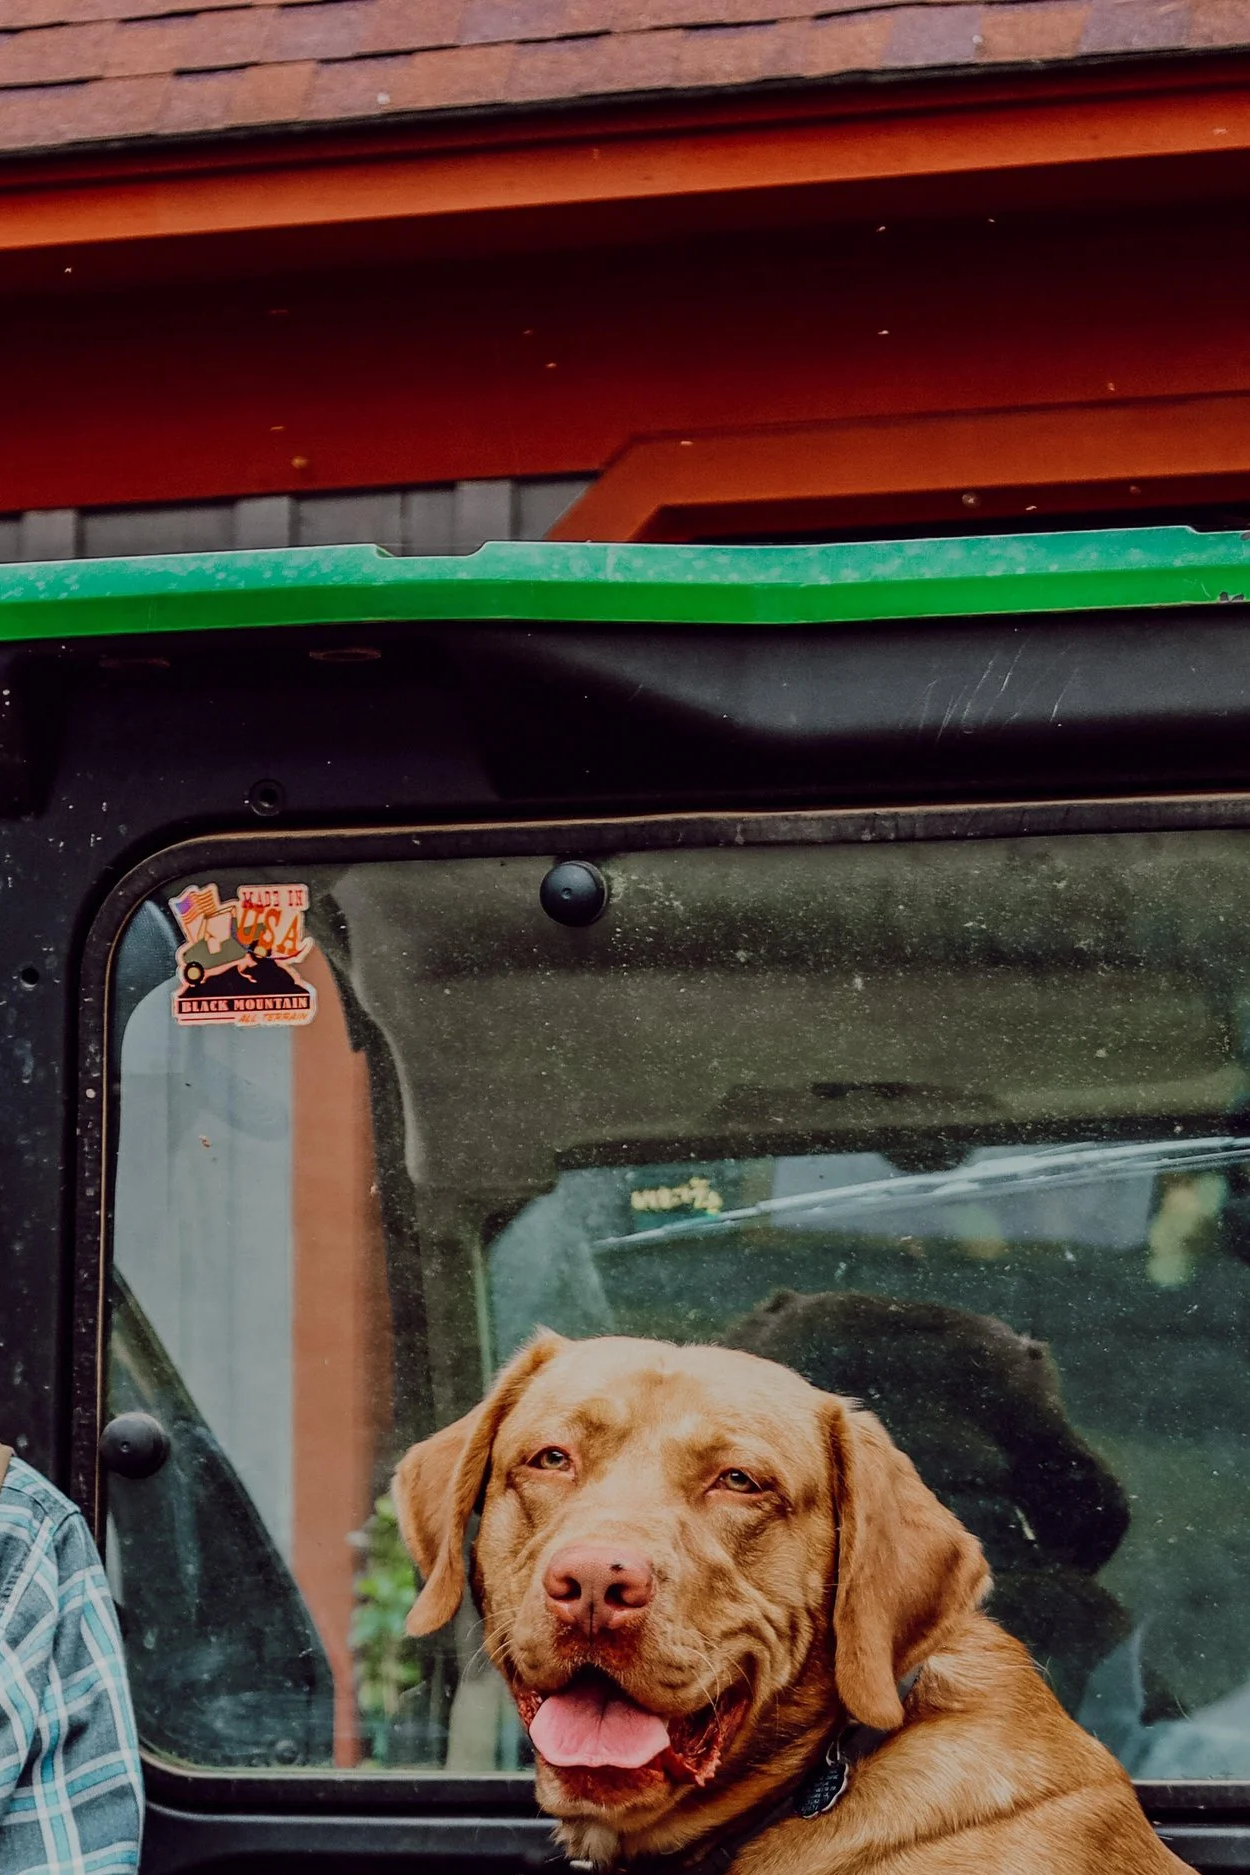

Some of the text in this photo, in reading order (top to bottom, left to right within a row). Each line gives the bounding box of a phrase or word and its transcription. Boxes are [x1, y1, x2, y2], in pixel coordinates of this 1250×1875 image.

[241, 889, 303, 908] MADE IN
[236, 905, 299, 956] USA
[181, 997, 308, 1013] BLACK MOUNTAIN
[262, 1011, 307, 1022] TERRAIN
